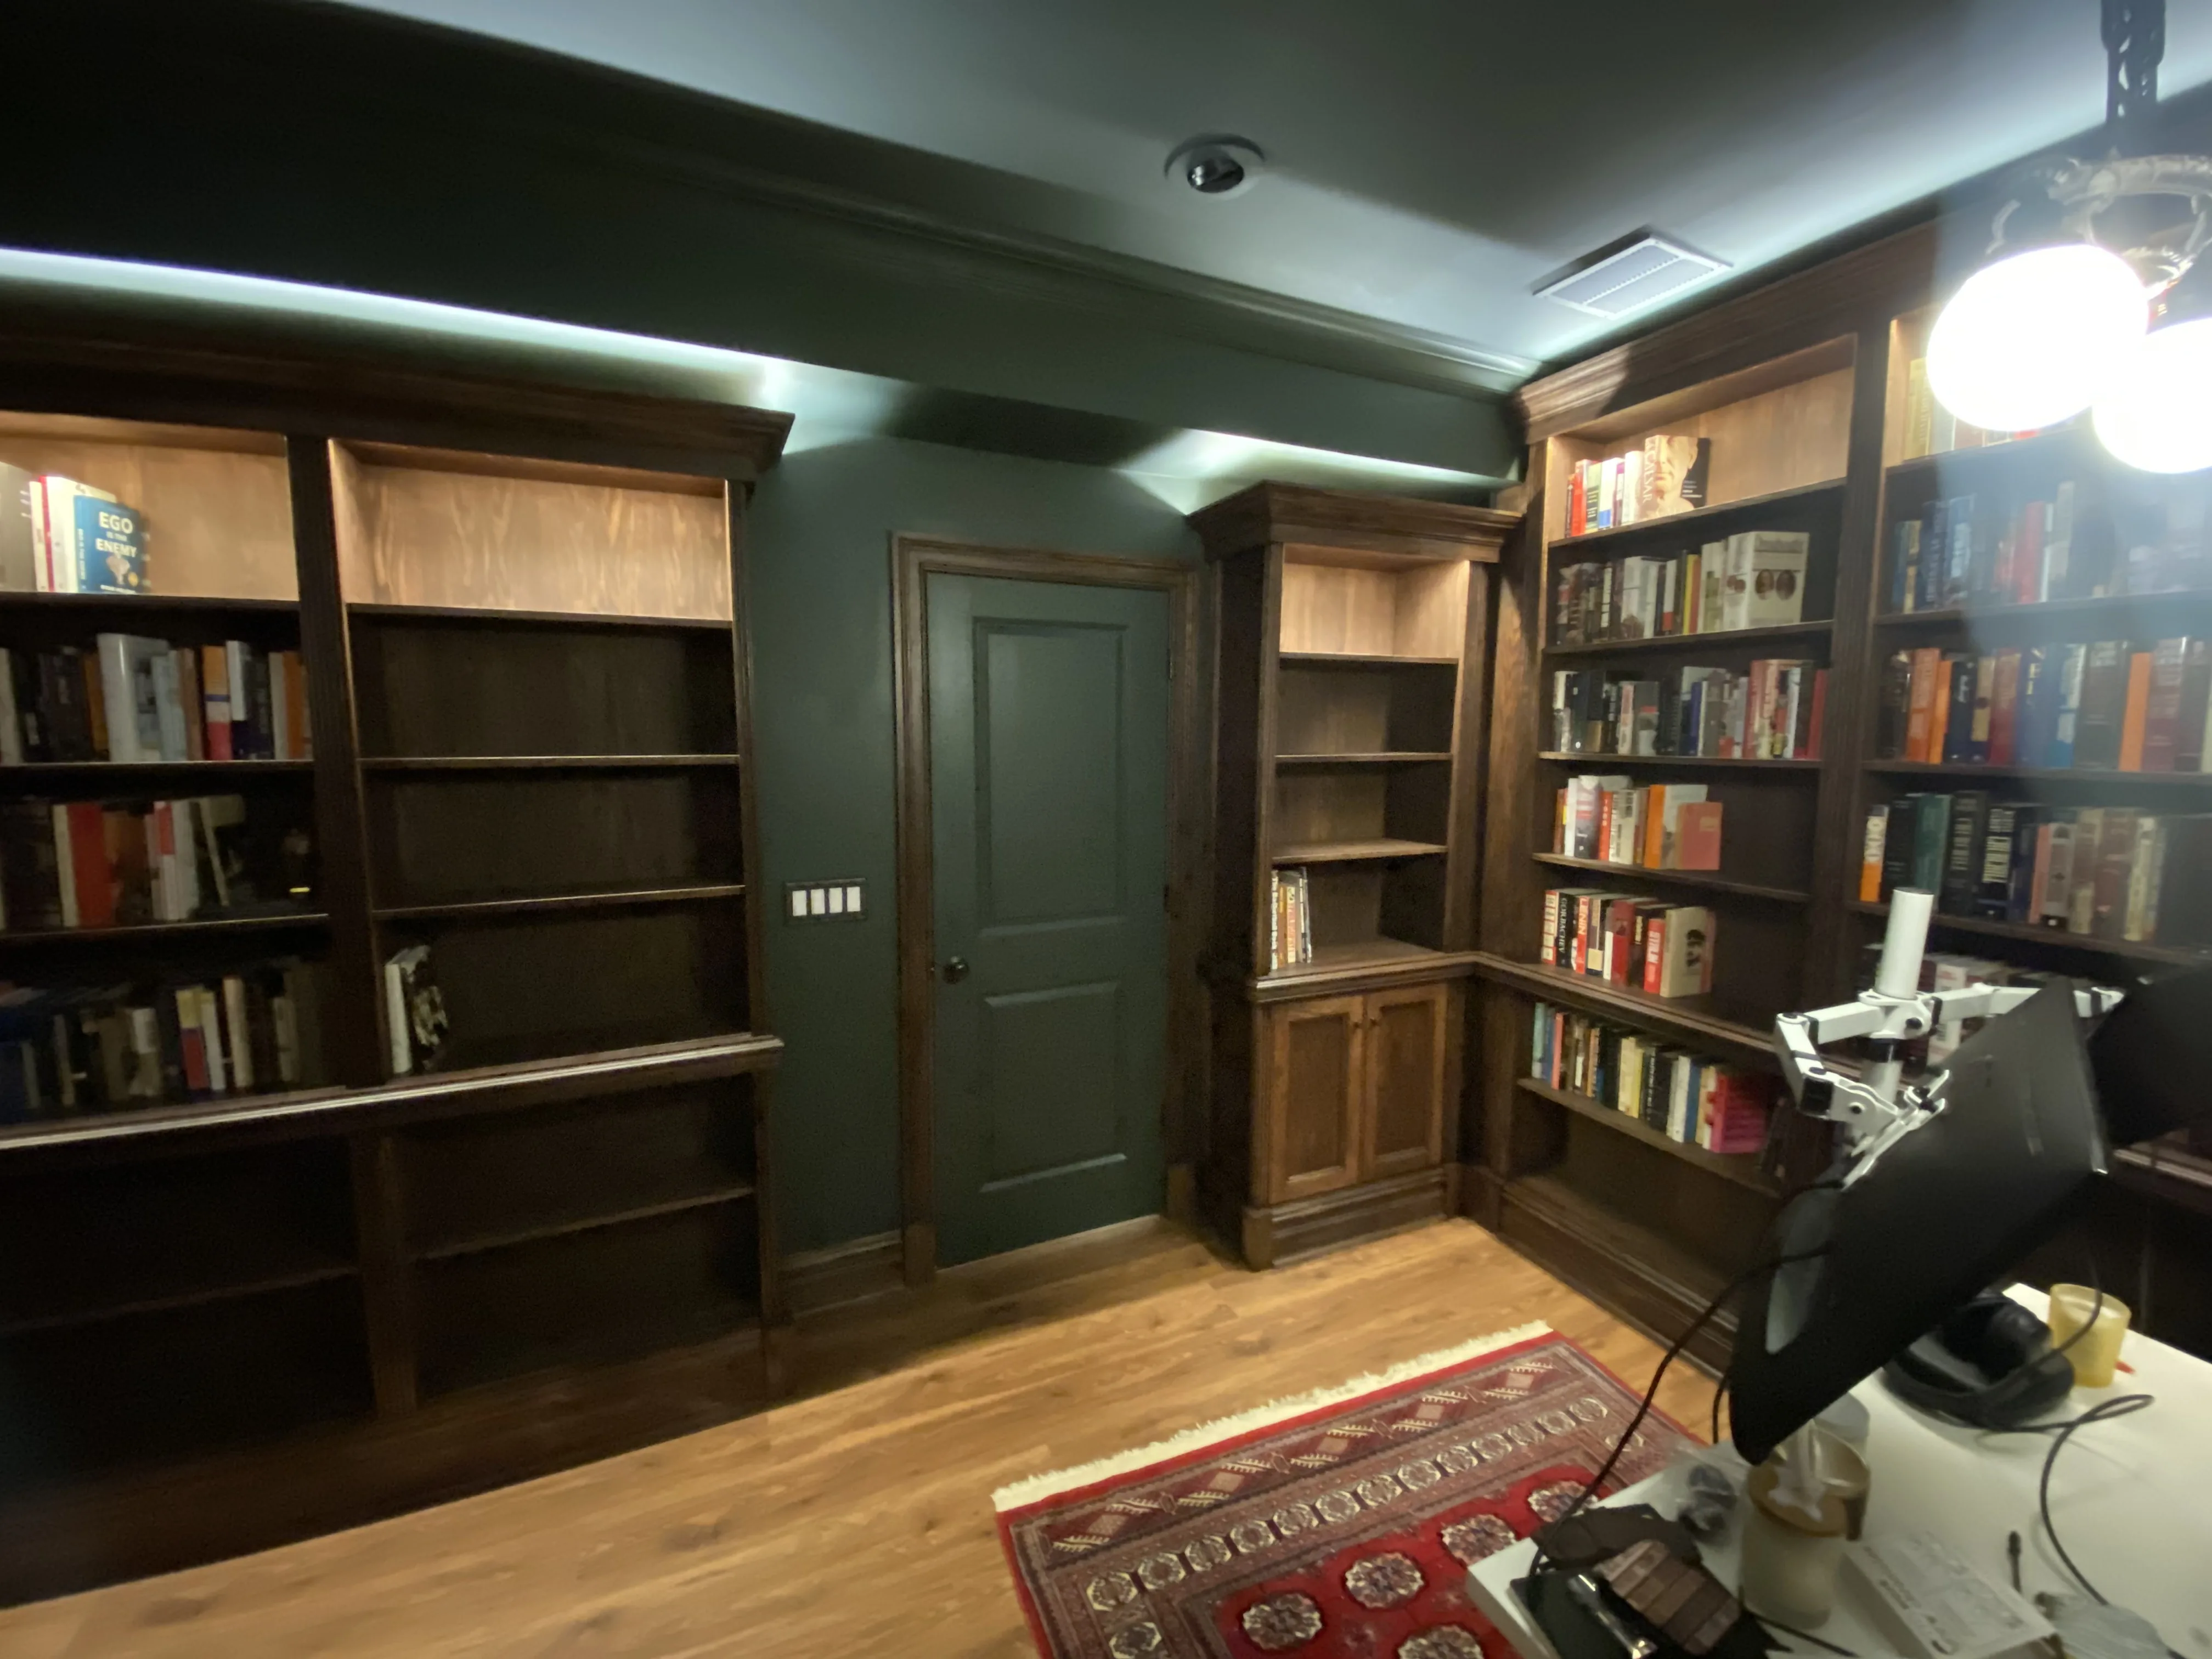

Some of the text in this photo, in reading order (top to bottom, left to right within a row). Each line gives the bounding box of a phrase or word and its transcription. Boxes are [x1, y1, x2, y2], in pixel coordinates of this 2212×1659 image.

[1643, 450, 1655, 504] CAESAR
[99, 511, 134, 534] EGO
[95, 538, 137, 557] ENEMY
[1559, 897, 1568, 953] GORBACHEV
[1577, 896, 1590, 935] LENIN
